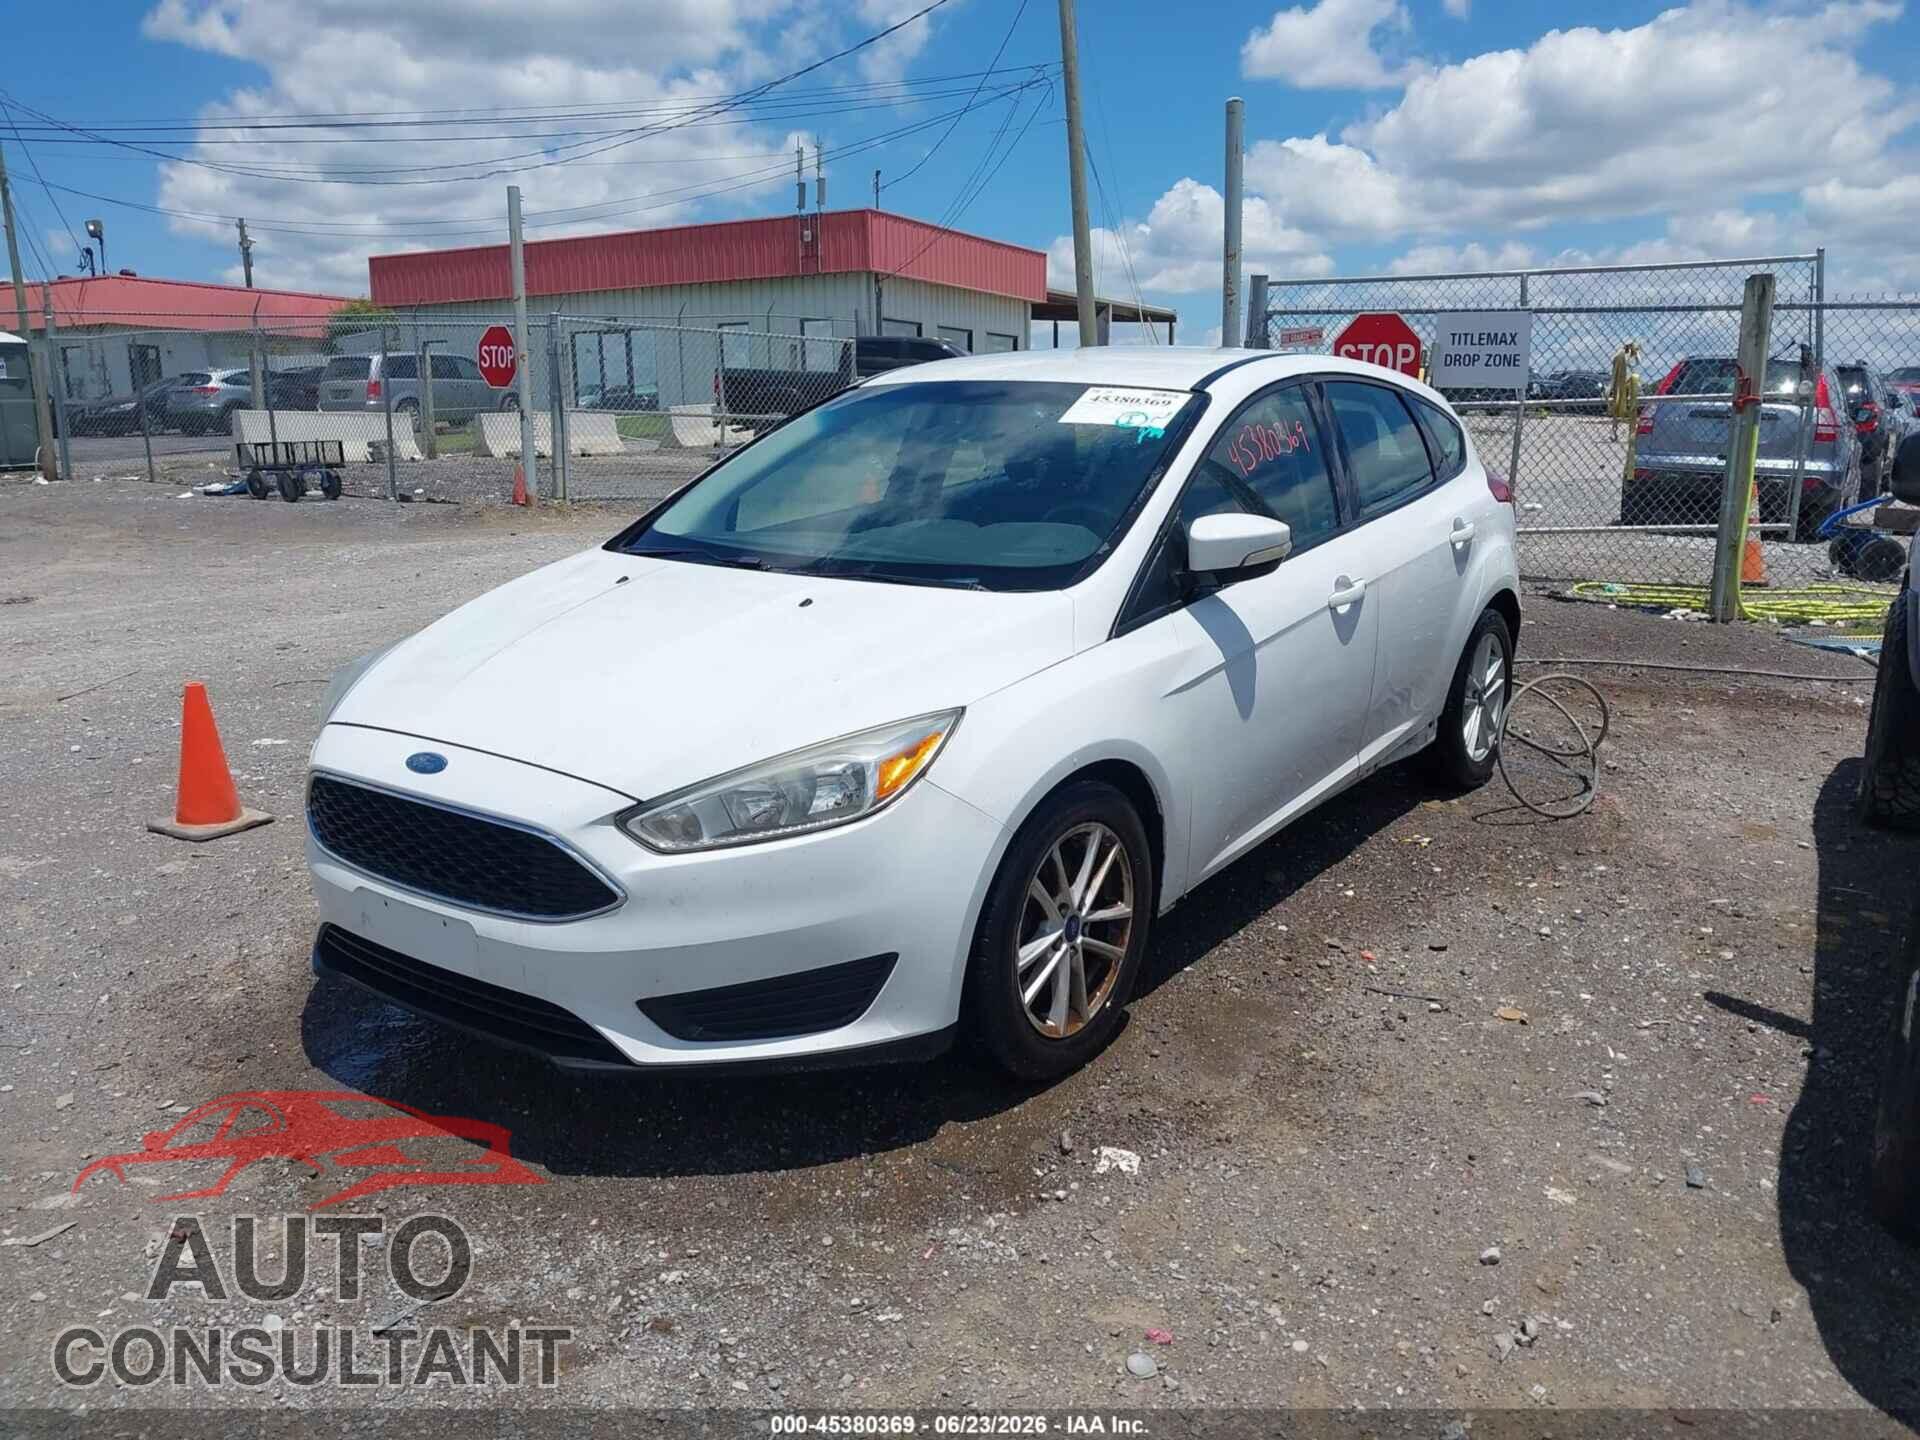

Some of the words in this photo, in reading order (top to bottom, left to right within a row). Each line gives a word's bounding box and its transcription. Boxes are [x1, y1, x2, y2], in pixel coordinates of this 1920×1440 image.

[1449, 332, 1518, 346] TITLEMAX
[480, 345, 514, 368] STOP
[1444, 353, 1480, 367] DROP
[1484, 353, 1521, 367] ZONE
